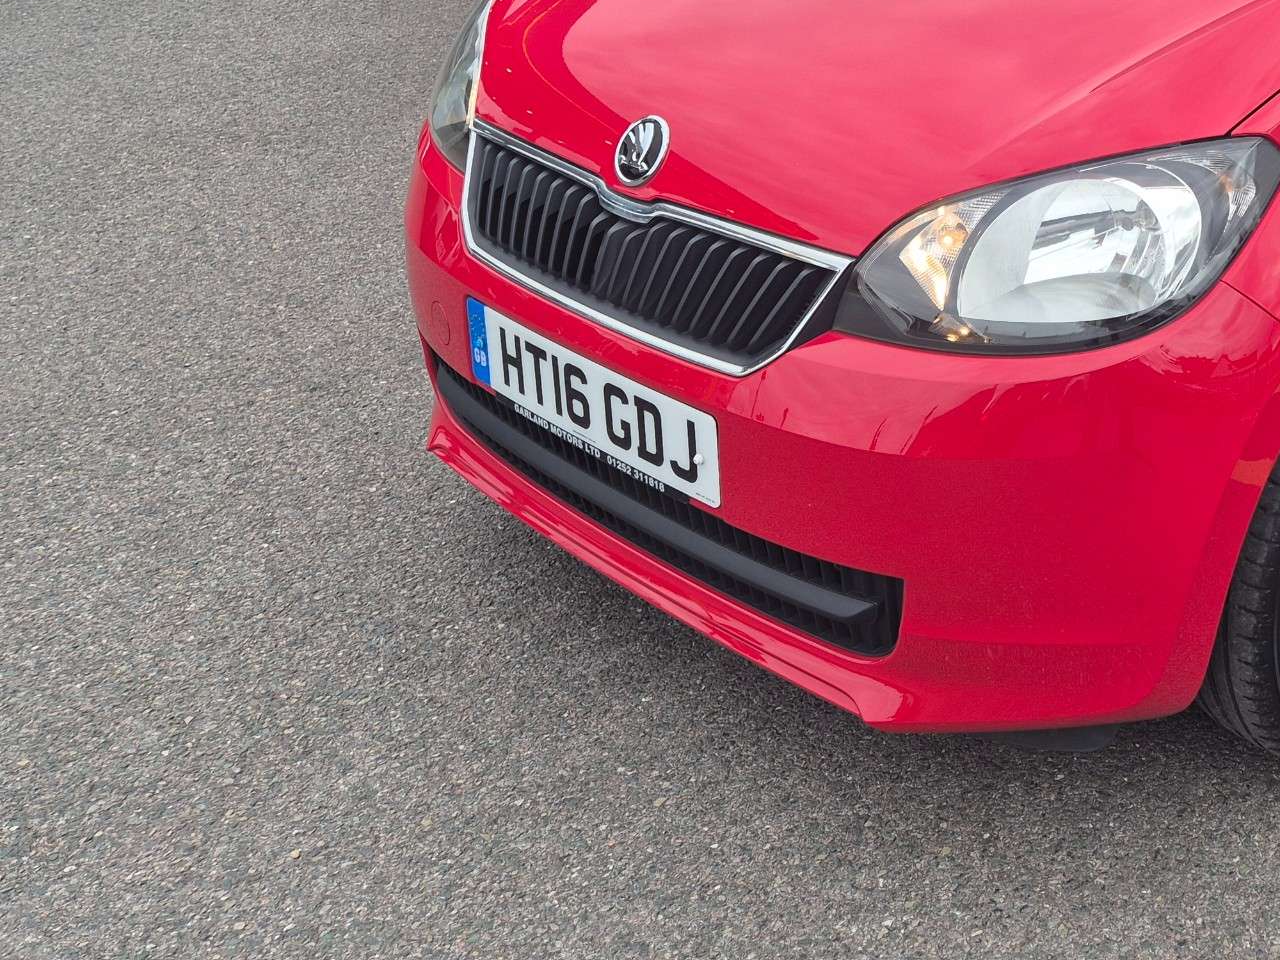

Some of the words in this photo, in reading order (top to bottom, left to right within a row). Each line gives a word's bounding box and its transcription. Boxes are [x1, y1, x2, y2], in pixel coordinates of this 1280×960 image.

[473, 347, 488, 367] GB
[499, 326, 591, 431] HT16
[603, 382, 699, 484] GDJ
[514, 404, 549, 430] GARLAND
[550, 425, 583, 450] MOTORS
[585, 444, 601, 458] LTD
[606, 455, 632, 477] 01252
